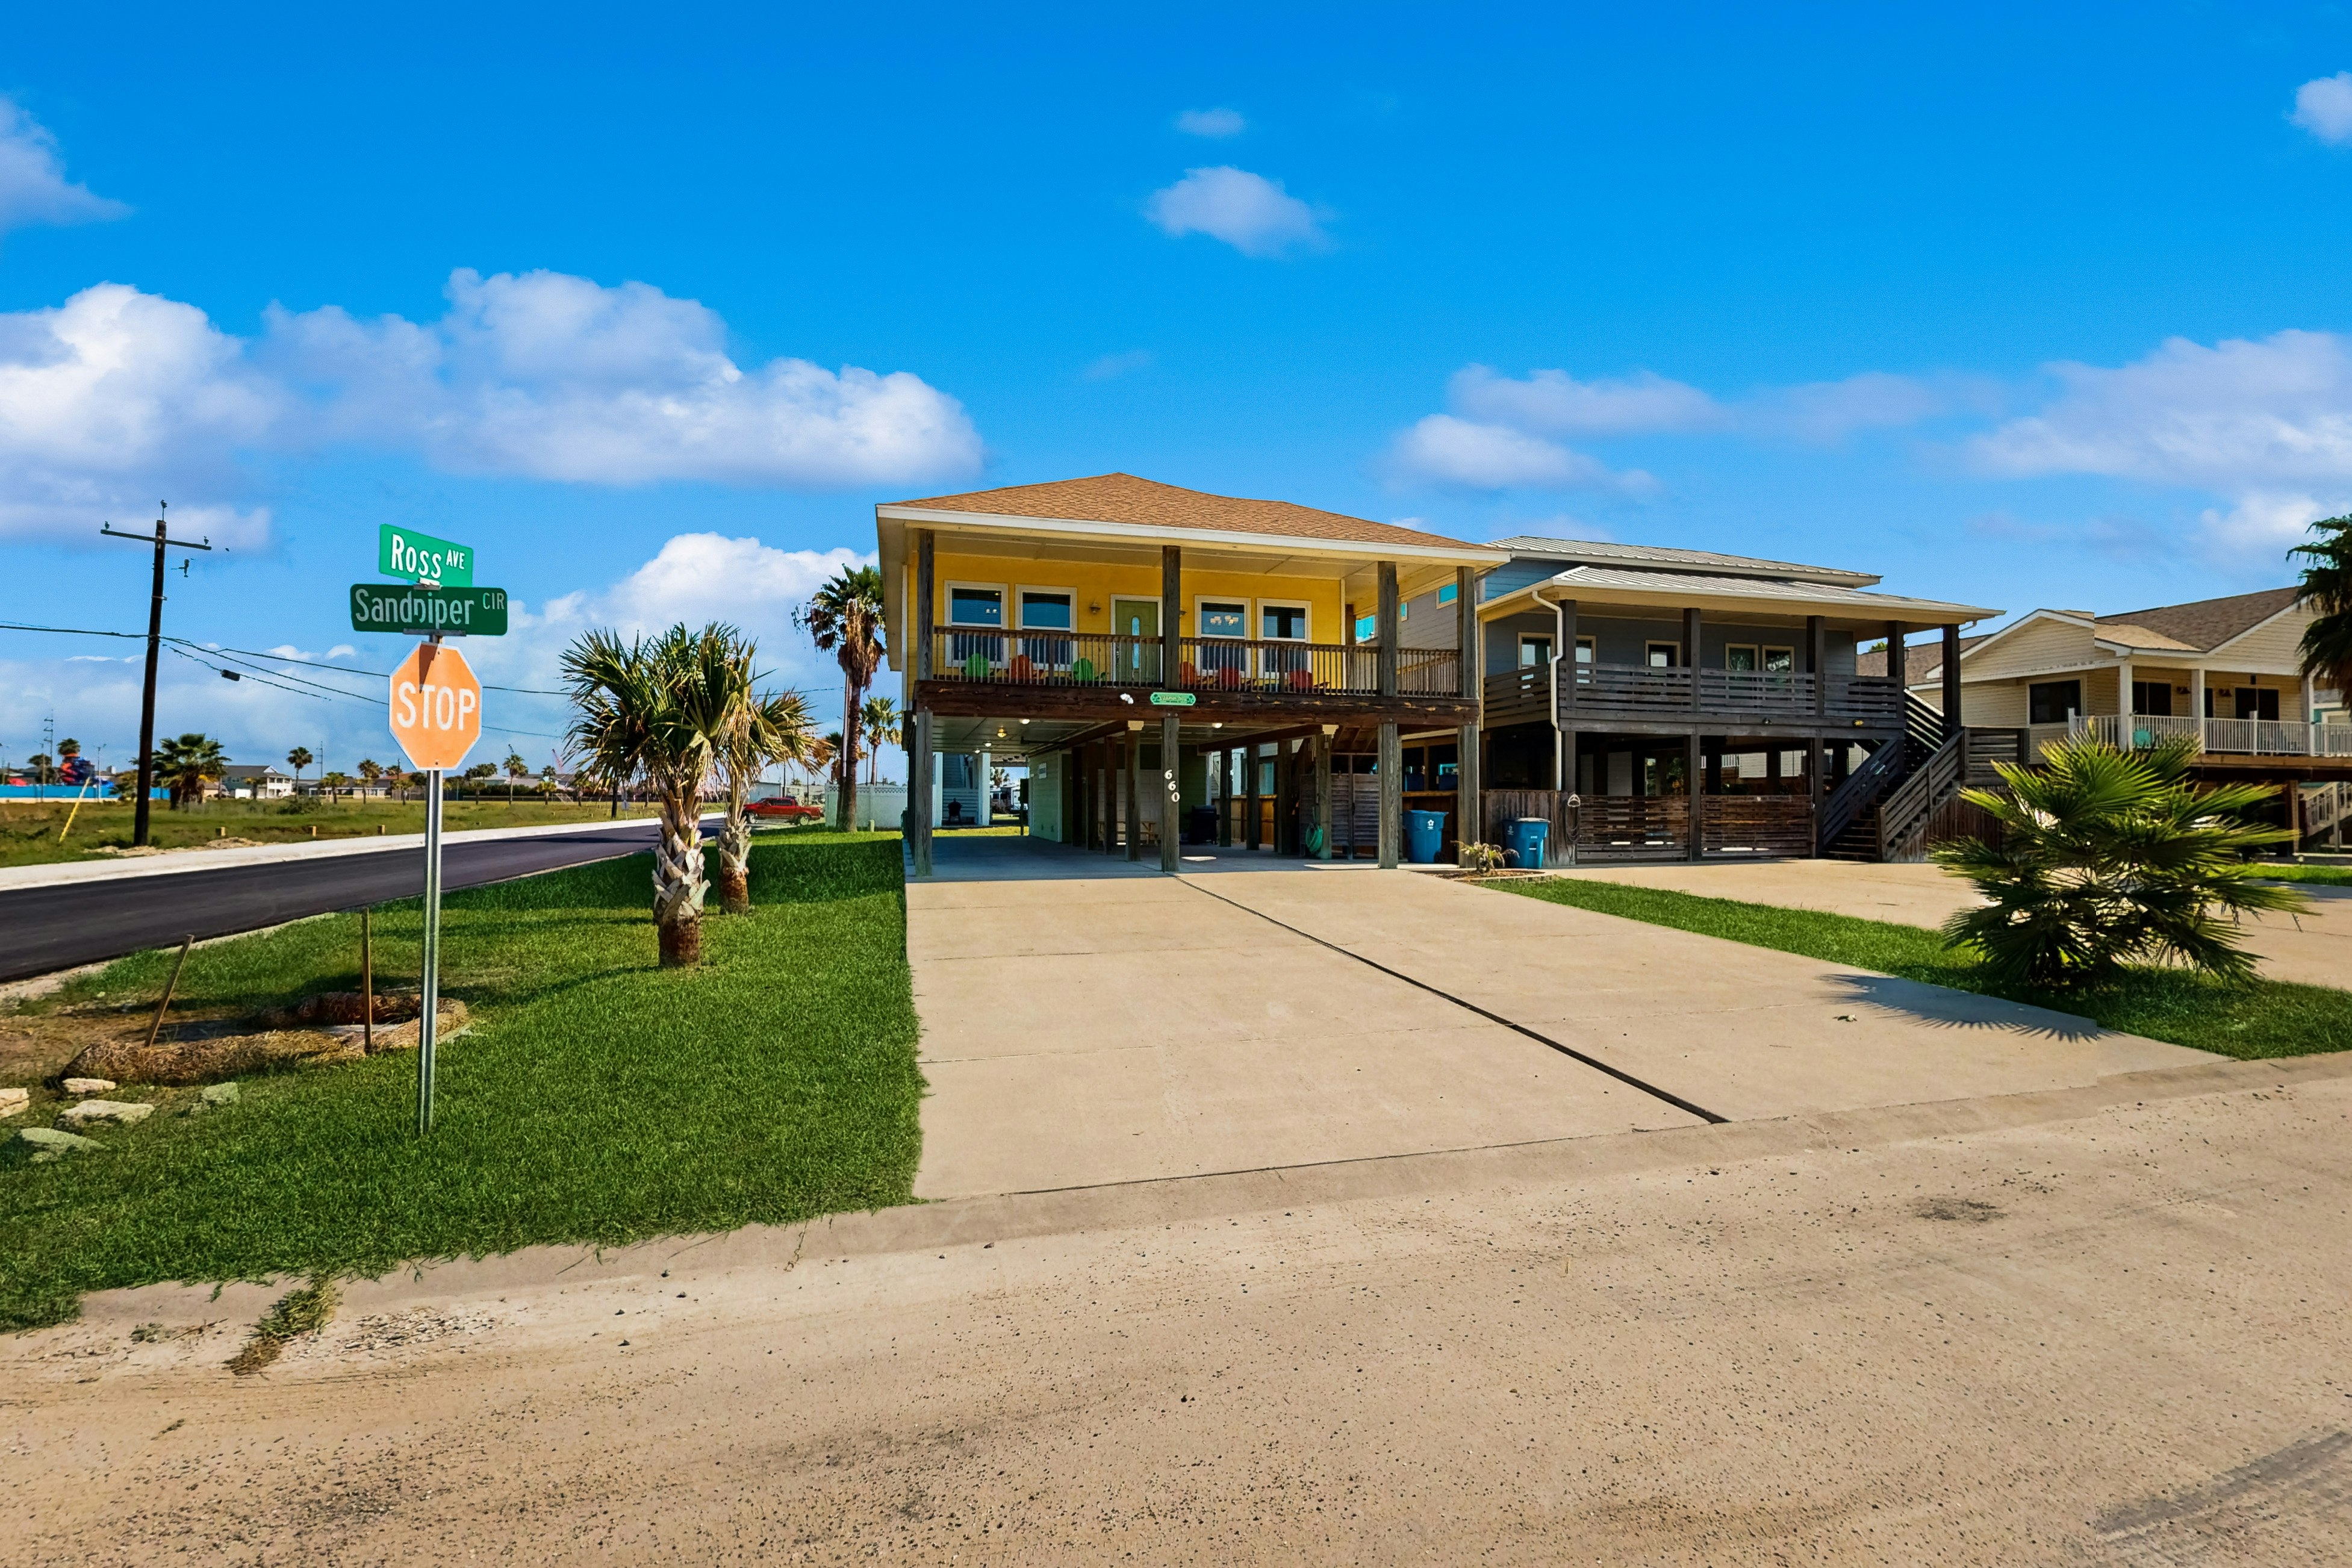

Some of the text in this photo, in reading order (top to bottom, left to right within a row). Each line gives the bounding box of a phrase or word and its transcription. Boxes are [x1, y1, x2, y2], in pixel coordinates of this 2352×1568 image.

[446, 549, 465, 570] AVE
[483, 592, 505, 610] CIR
[396, 681, 476, 730] STOP
[1164, 769, 1180, 802] 660
